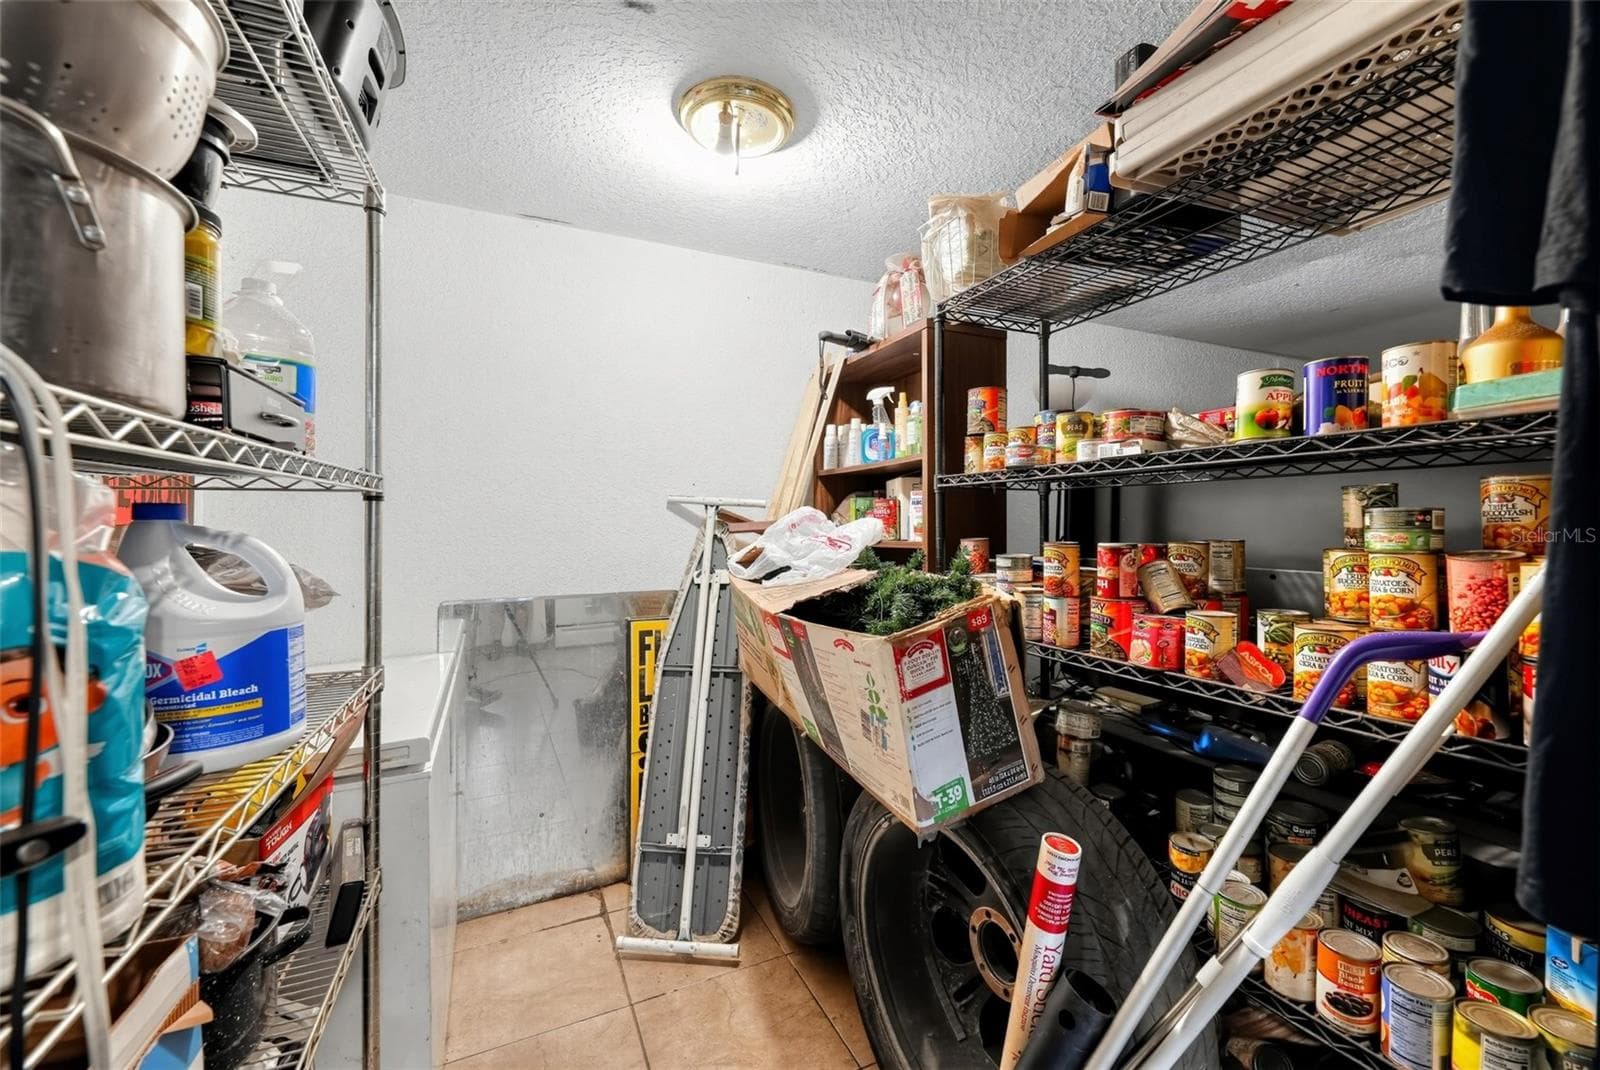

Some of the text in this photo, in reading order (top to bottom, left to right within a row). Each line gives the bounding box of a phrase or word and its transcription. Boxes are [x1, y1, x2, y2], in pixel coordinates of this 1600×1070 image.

[1334, 379, 1363, 389] FRUIT
[971, 614, 987, 627] $89
[150, 684, 259, 706] Germicidal Bleach
[1038, 942, 1064, 984] Yard
